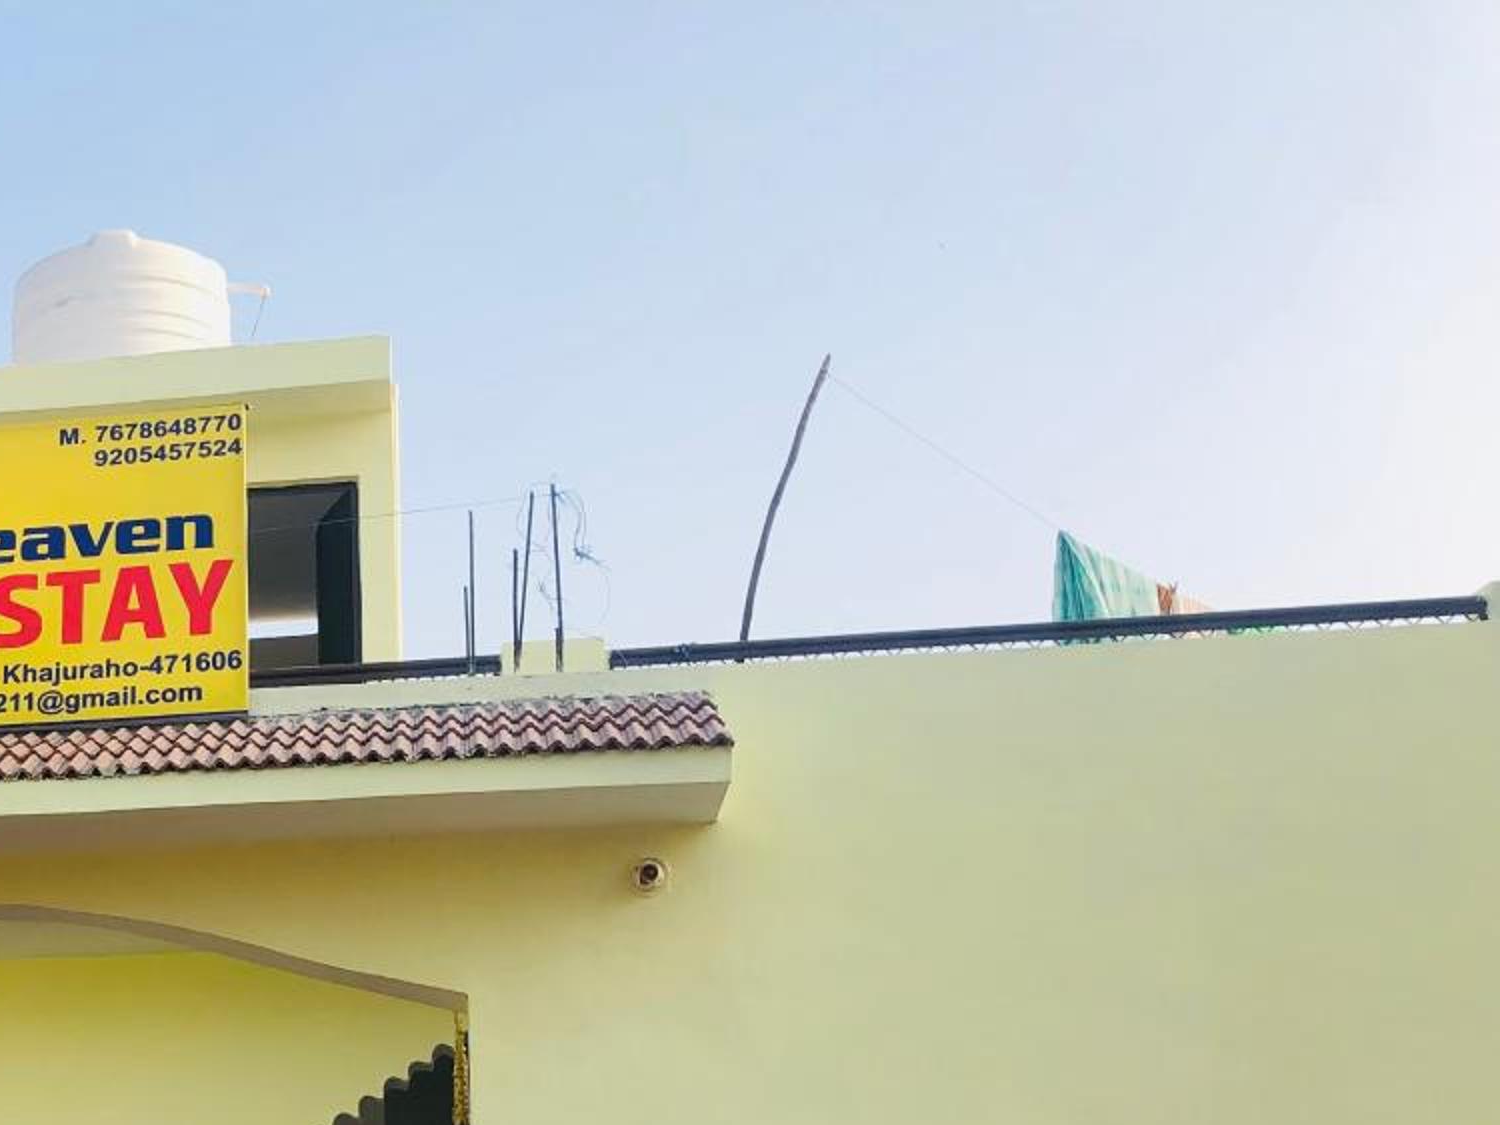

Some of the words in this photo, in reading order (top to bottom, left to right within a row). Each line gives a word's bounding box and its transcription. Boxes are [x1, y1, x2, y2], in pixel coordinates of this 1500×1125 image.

[59, 427, 87, 446] M.
[95, 413, 242, 443] 7678648770
[94, 438, 242, 467] 9205457524
[3, 650, 243, 687] Khajuraho-471606
